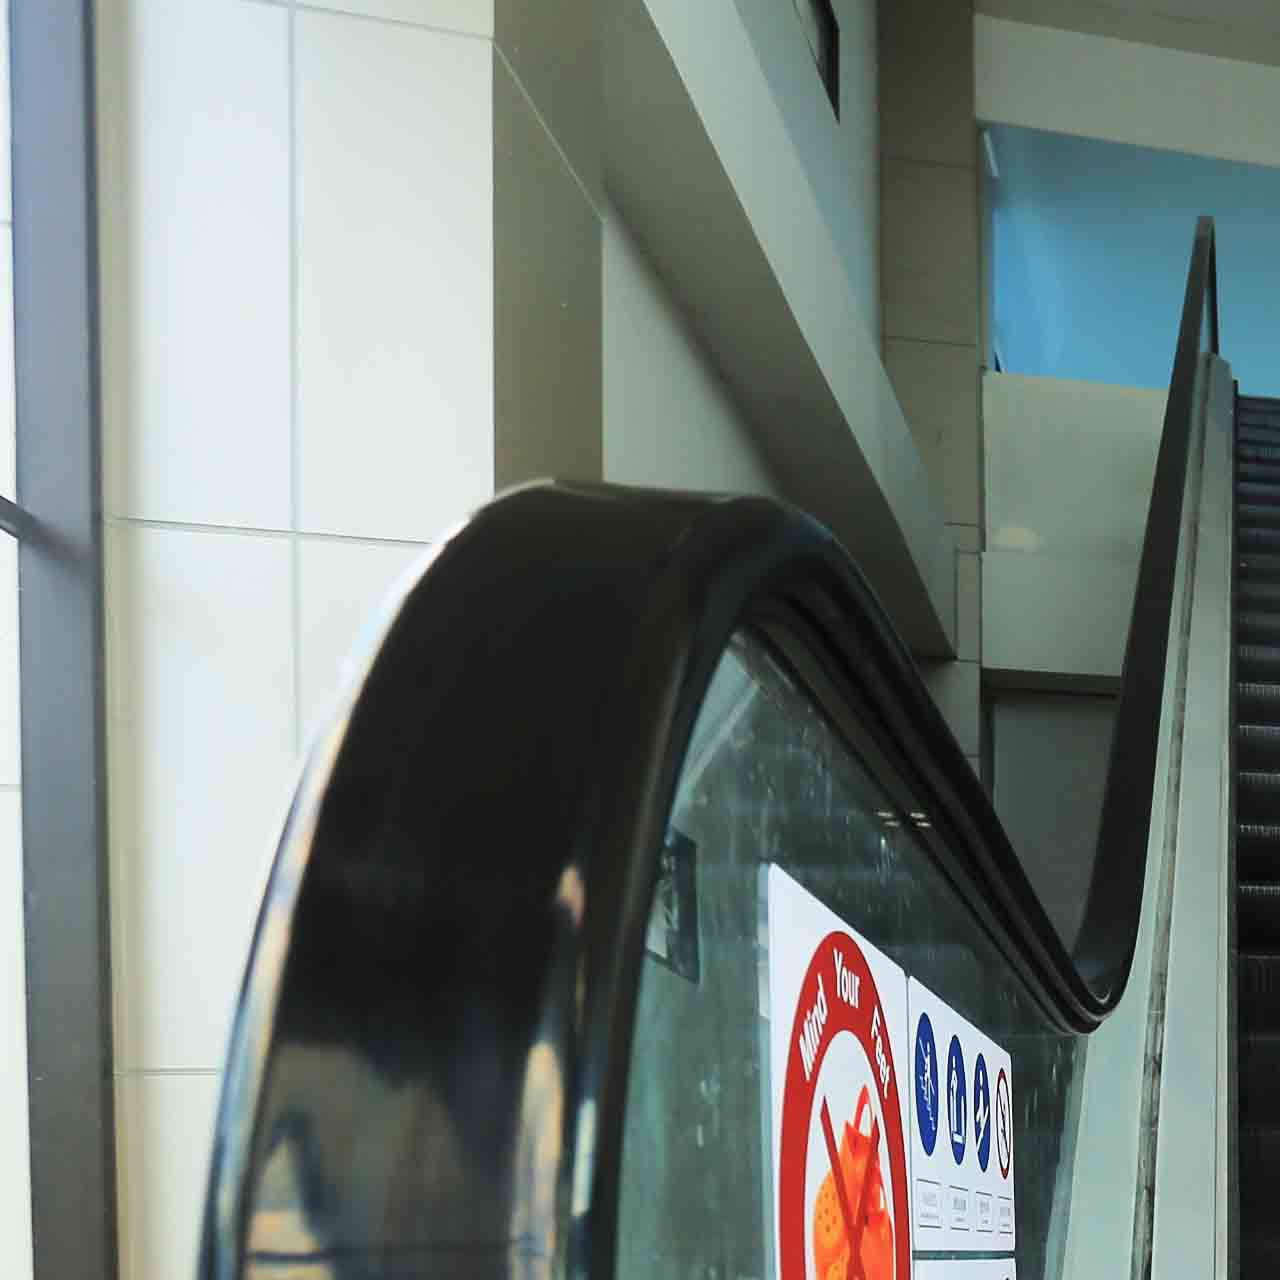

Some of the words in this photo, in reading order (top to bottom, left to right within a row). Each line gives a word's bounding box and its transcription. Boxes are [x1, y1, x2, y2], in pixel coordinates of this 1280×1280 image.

[799, 972, 828, 1082] Mind
[832, 947, 861, 1009] Your
[870, 1005, 891, 1099] Feet
